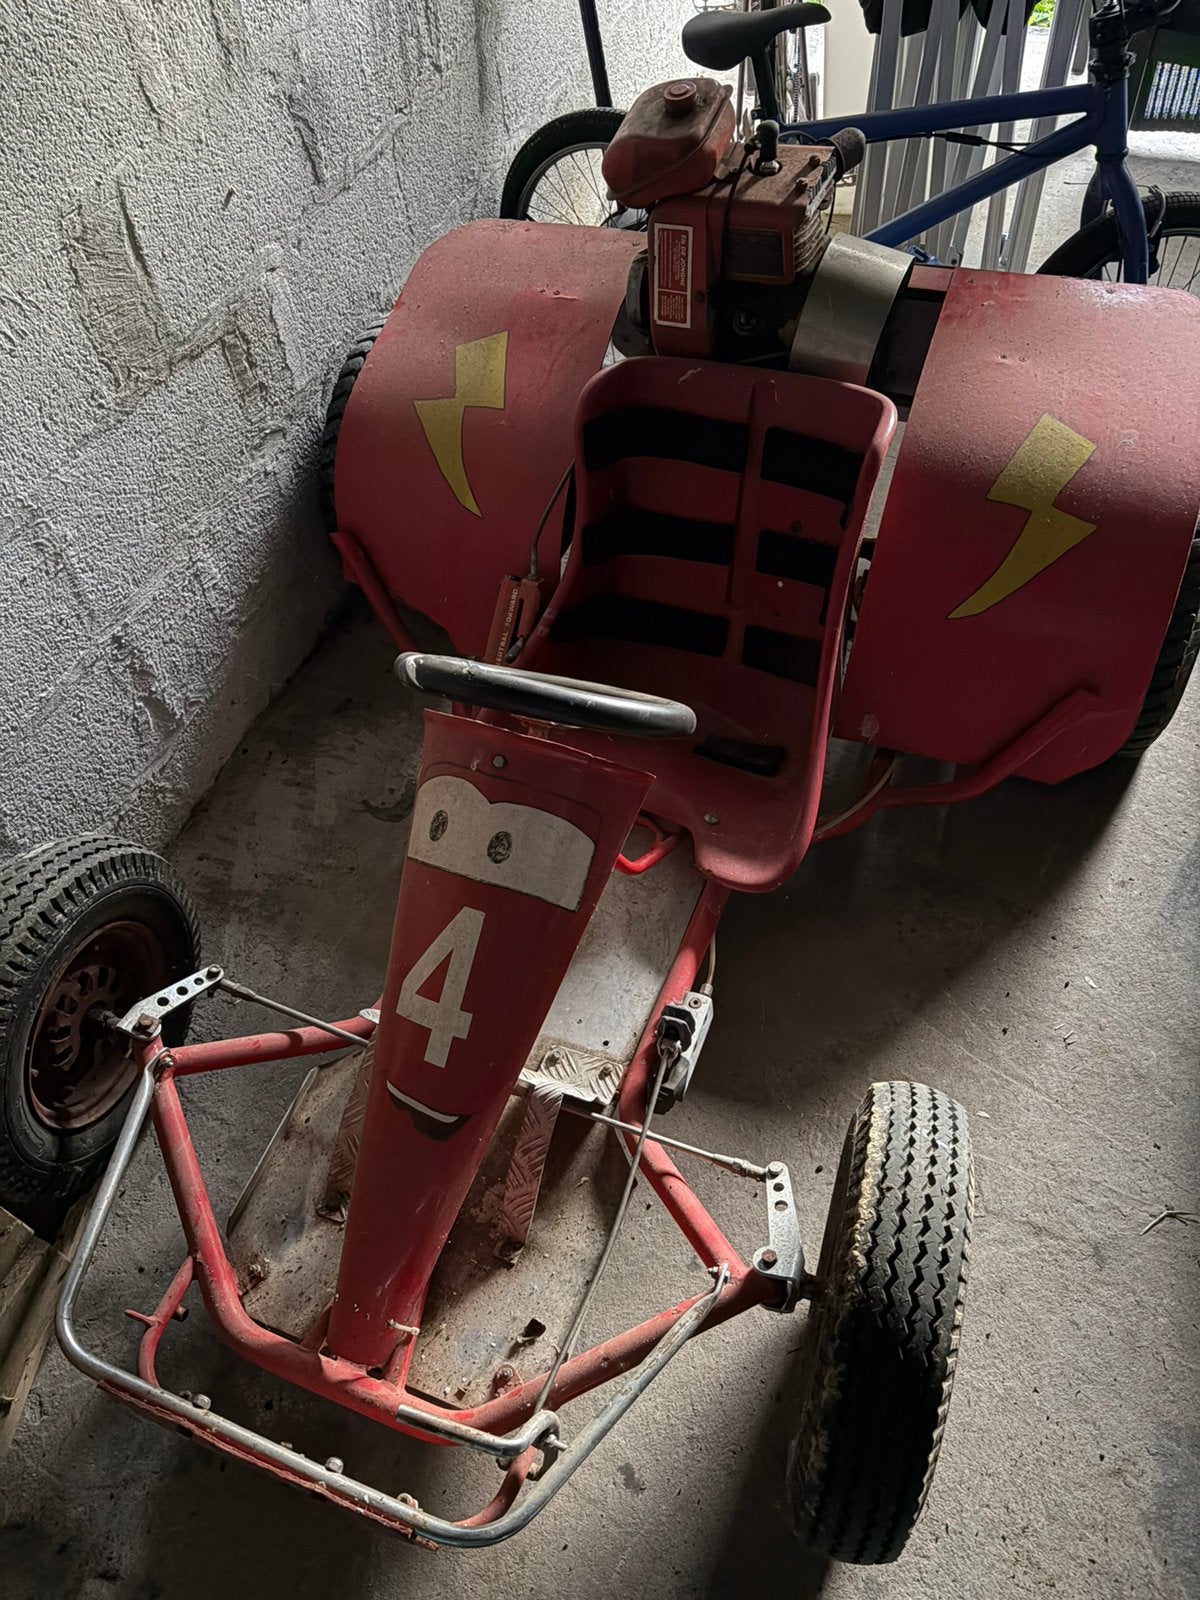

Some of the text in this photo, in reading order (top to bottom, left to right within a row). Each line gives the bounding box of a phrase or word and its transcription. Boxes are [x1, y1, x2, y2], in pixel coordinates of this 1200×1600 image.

[680, 246, 687, 256] DE
[504, 589, 518, 627] FORWARD
[396, 906, 485, 1068] 4
